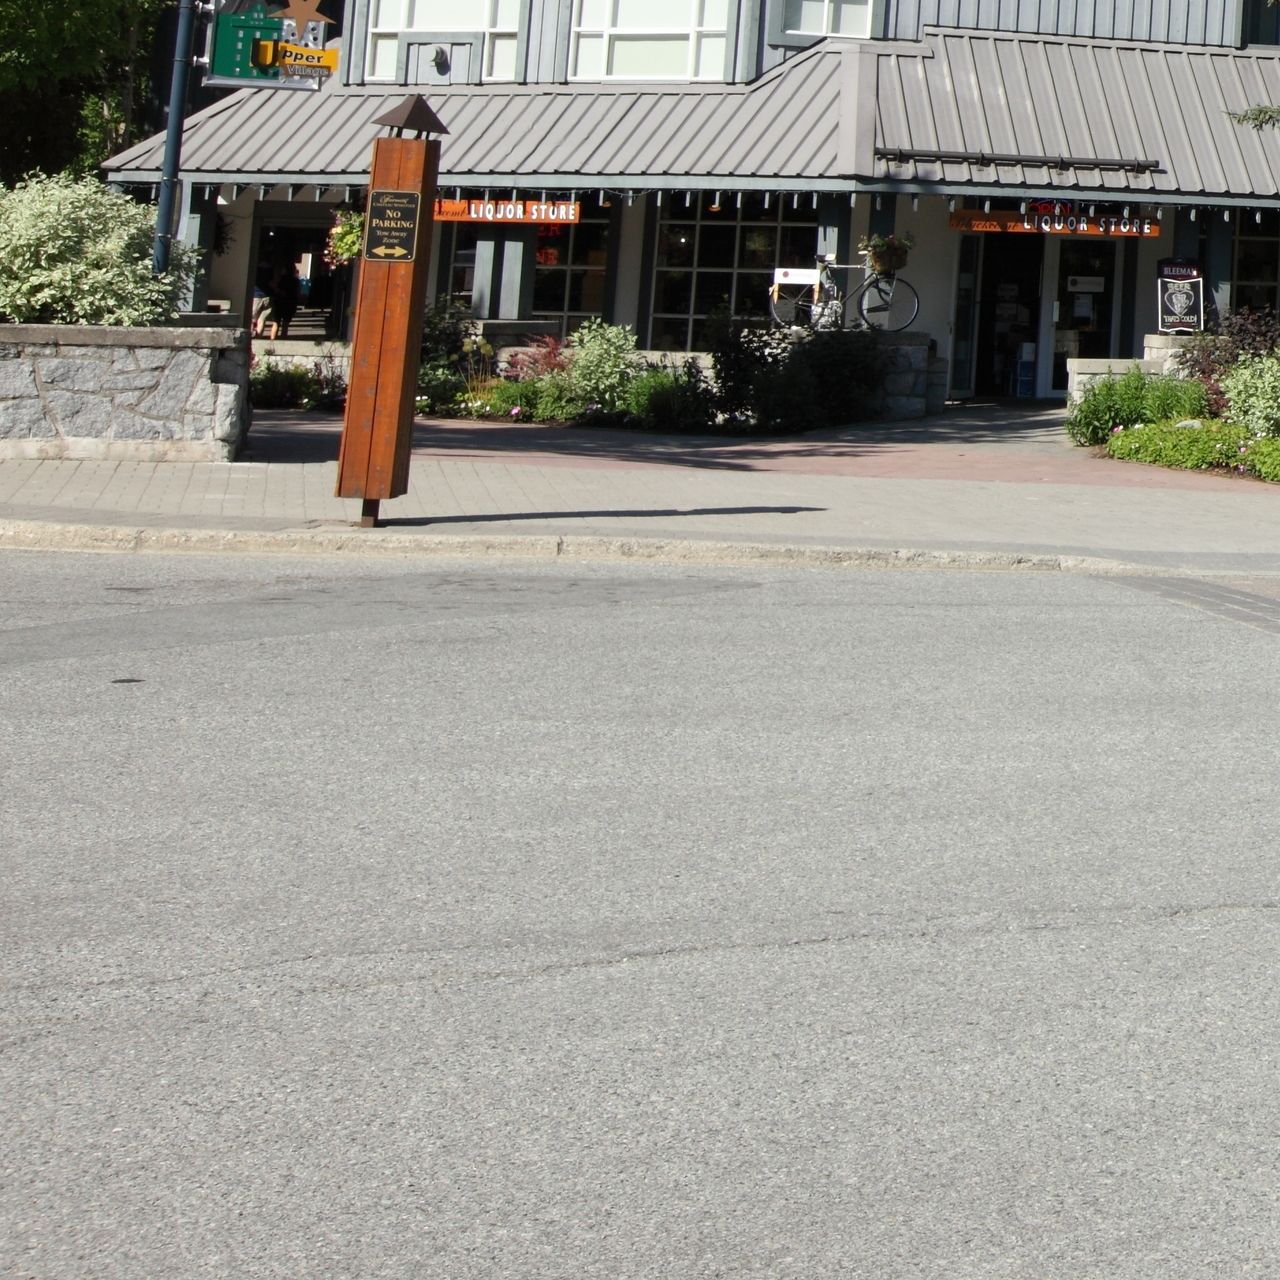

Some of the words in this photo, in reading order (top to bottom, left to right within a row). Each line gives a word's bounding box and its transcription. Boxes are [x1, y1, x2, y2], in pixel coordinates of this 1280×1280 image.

[385, 209, 401, 218] NO
[470, 203, 524, 220] LIQUOR
[531, 204, 576, 220] STORE
[372, 218, 414, 228] PARKING
[1023, 215, 1088, 232] LIQUOR
[1099, 218, 1151, 233] STORE
